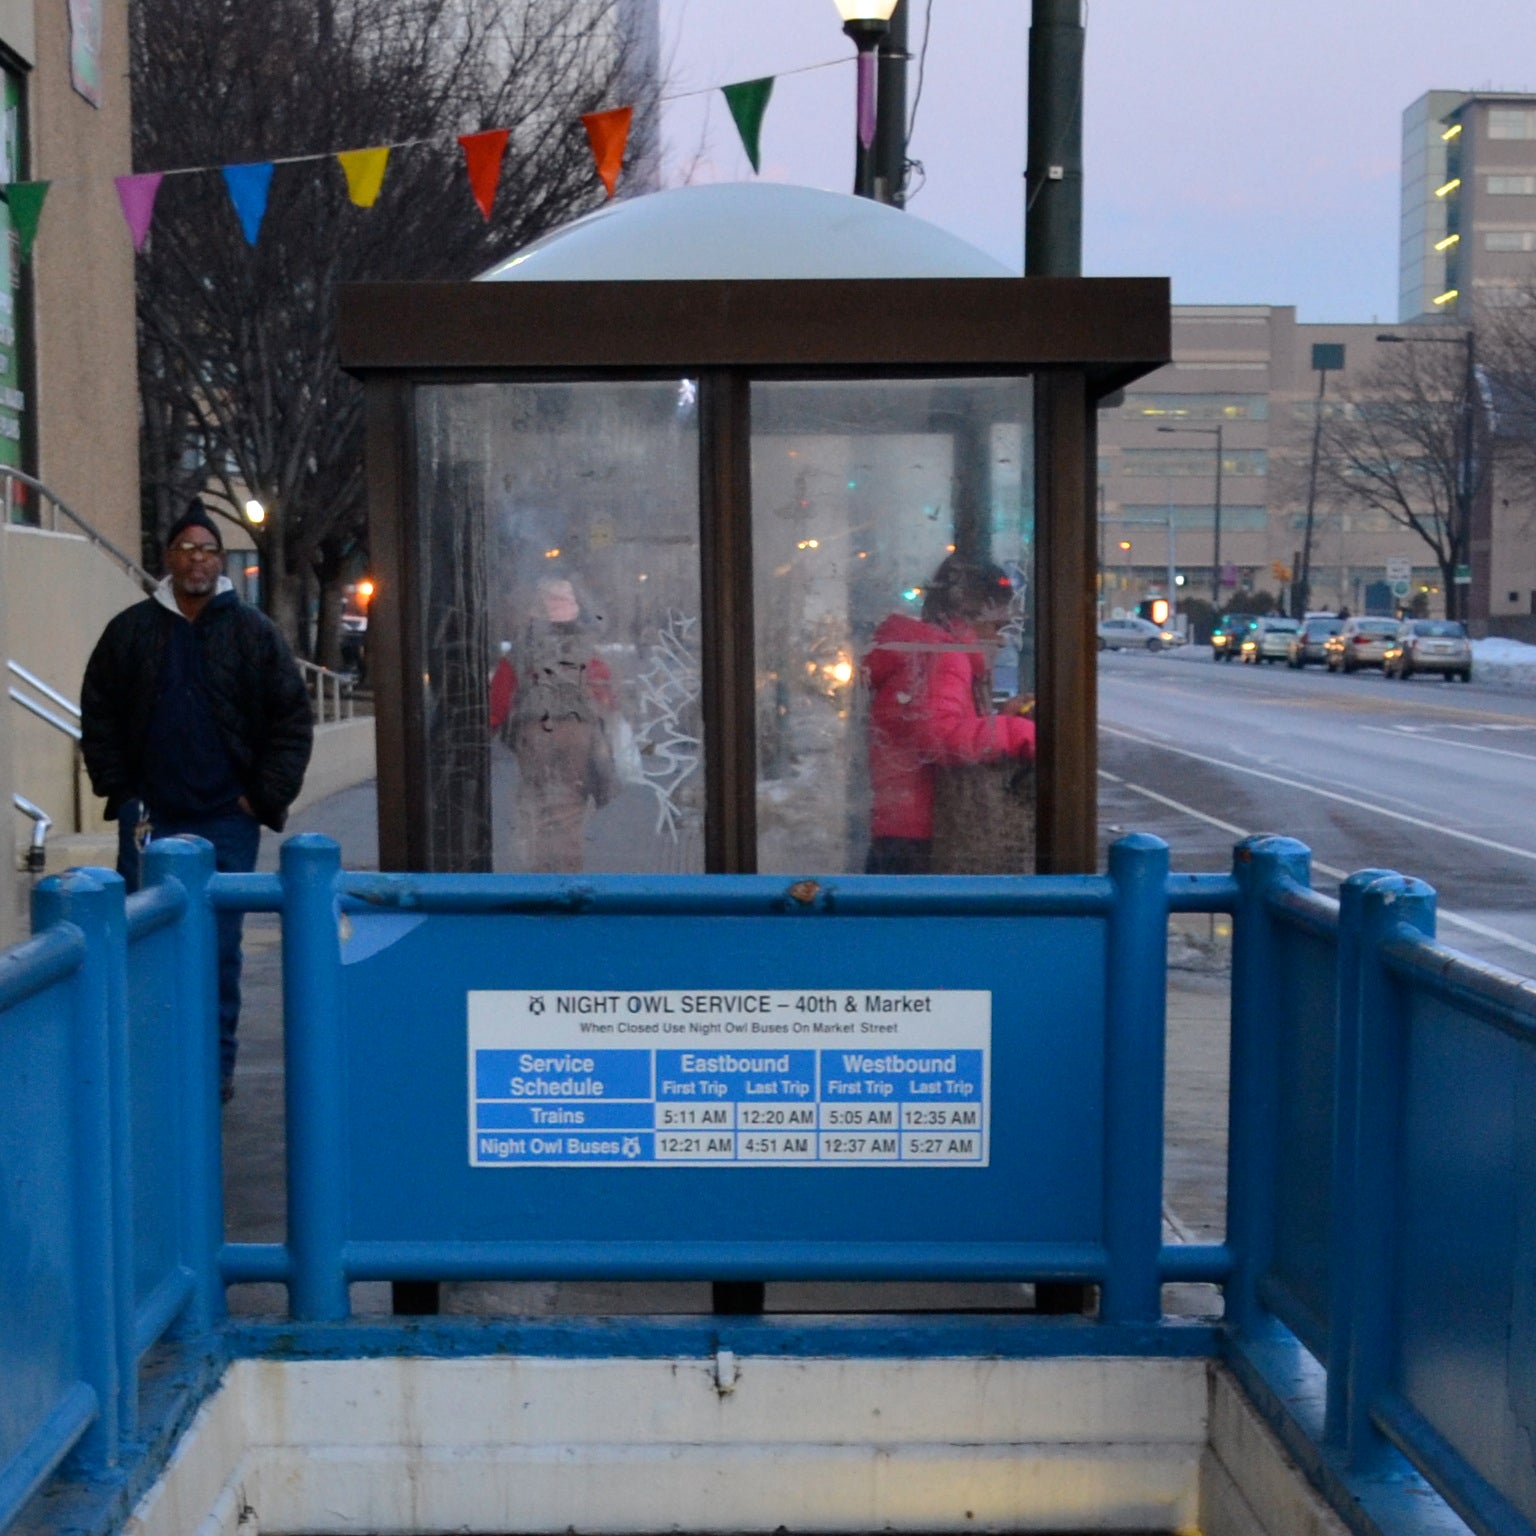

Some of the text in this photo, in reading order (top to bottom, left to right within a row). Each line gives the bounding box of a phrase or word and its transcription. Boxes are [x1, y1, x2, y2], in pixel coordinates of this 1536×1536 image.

[557, 996, 620, 1014] NIGHT
[627, 995, 674, 1014] OWL
[681, 995, 771, 1014] SERVICE
[795, 995, 837, 1013] 40th
[844, 995, 857, 1013] &
[865, 995, 931, 1013] Market
[580, 1022, 898, 1036] When Closed Use Night Owl Buses On Market Street
[519, 1054, 595, 1073] Service
[681, 1054, 790, 1073] Eastbound
[843, 1054, 957, 1074] Westbound
[510, 1077, 604, 1096] Schedule
[662, 1080, 728, 1098] First Trip
[746, 1080, 810, 1098] Last Trip
[828, 1080, 894, 1097] First Trip
[910, 1080, 974, 1097] Last Trip
[530, 1107, 585, 1124] Trains
[664, 1110, 727, 1124] 5:11 AM
[743, 1110, 814, 1125] 12:20 AM
[829, 1110, 892, 1125] 5:05 AM
[905, 1110, 976, 1125] 12:35 AM
[481, 1138, 620, 1158] Night Owl Buses
[661, 1139, 732, 1152] 12:21 AM
[745, 1138, 808, 1152] 4:51 AM
[825, 1138, 896, 1153] 12:37 AM
[910, 1139, 973, 1153] 5:27 AM
